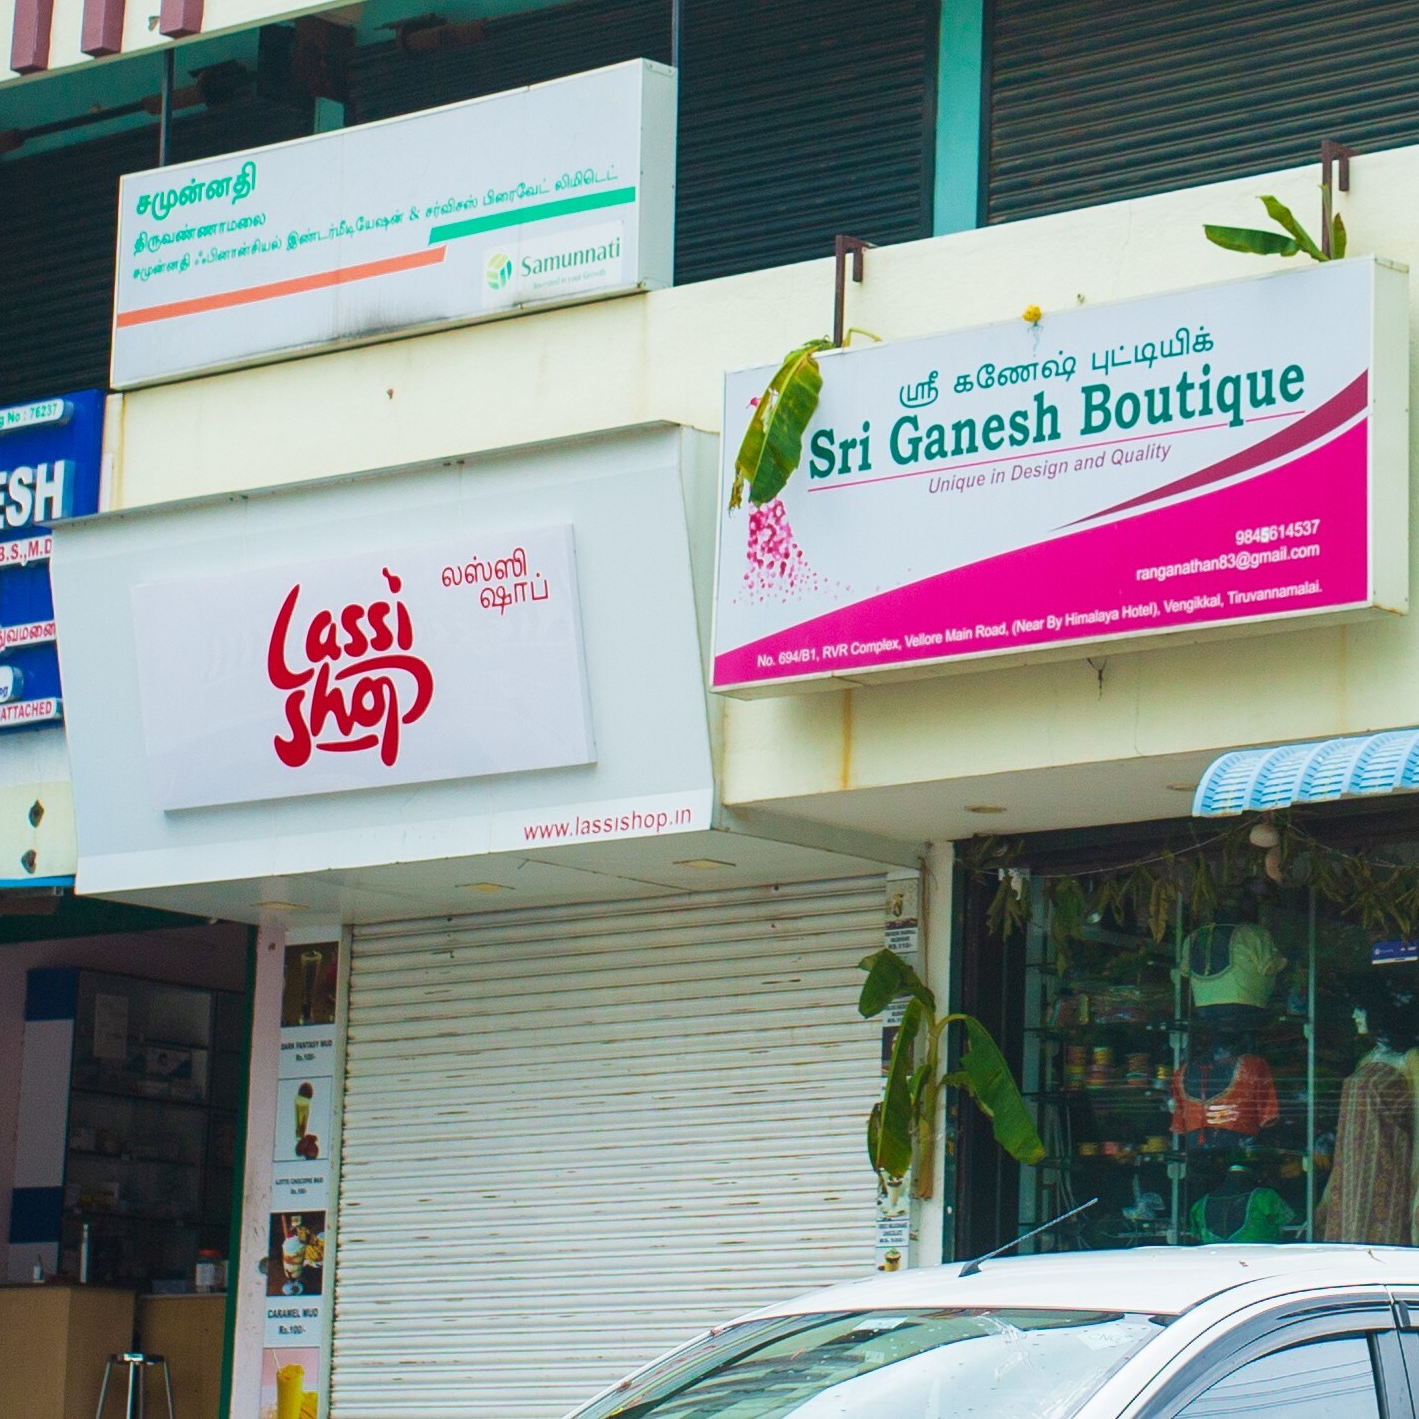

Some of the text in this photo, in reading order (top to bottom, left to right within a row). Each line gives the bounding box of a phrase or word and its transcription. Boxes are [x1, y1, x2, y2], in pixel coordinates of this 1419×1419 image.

[135, 160, 258, 222] சமுன்னதி
[132, 253, 191, 282] சமுன்னதி
[408, 205, 420, 222] &
[483, 177, 550, 207] பிரைவேட்
[133, 212, 267, 257] திருவண்ணாமலை
[520, 236, 622, 278] Samunnati
[899, 325, 1215, 408] ஸ்ரீ கணேஷ் புட்டியிக்
[7, 410, 22, 425] No
[29, 401, 59, 419] 76237
[808, 362, 1306, 480] Sri Ganesh Boutique
[928, 442, 1172, 496] Unique in Design and Quality
[1235, 518, 1321, 545] 9845614537
[440, 546, 528, 590] லஸ்ஸி
[1135, 543, 1321, 583] ranganathan83@gmail.com
[479, 570, 551, 616] ஷாப்
[267, 566, 416, 690] Lassi
[756, 578, 1323, 668] No. 694/B1, RVR Complex, Vellore Main Road, (Near By Himalaya Hotel), Vengikkal, Tiruvannamalai.
[0, 700, 52, 721] ATTACHED
[522, 804, 693, 843] www.lassishop.in
[267, 1307, 319, 1319] CARAMEL MUD
